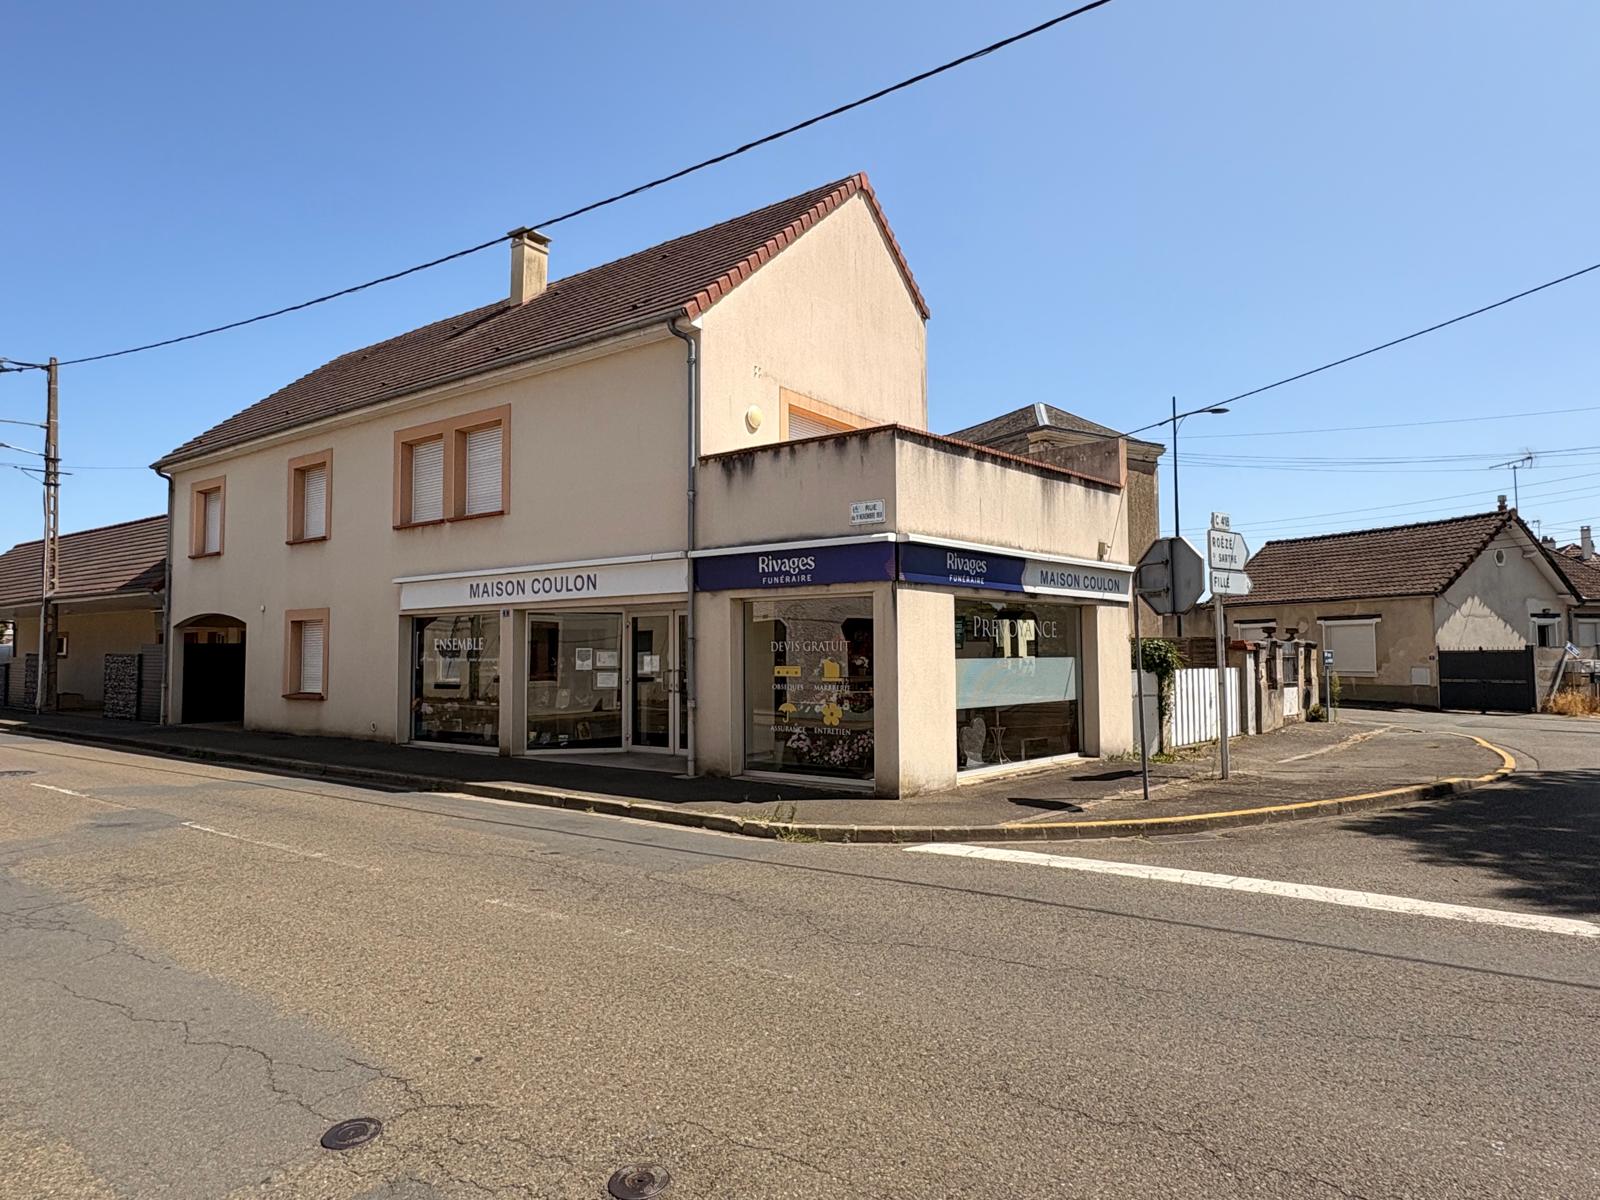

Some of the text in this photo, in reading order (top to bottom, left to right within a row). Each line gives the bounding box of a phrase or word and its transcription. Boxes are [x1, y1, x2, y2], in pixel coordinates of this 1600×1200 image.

[758, 555, 816, 575] Rivages
[946, 552, 987, 575] Rivages
[469, 573, 597, 599] MAISON COULON
[762, 574, 812, 585] FUNÉRAIRE
[949, 574, 985, 585] FUNÉRAIRE
[1040, 569, 1120, 592] MAISON COULON
[973, 615, 1057, 638] PRÉVOYANCE
[433, 637, 484, 651] ENSEMBLE
[770, 641, 851, 652] DEVIS GRATUIT
[814, 726, 851, 736] ENTRETIEN
